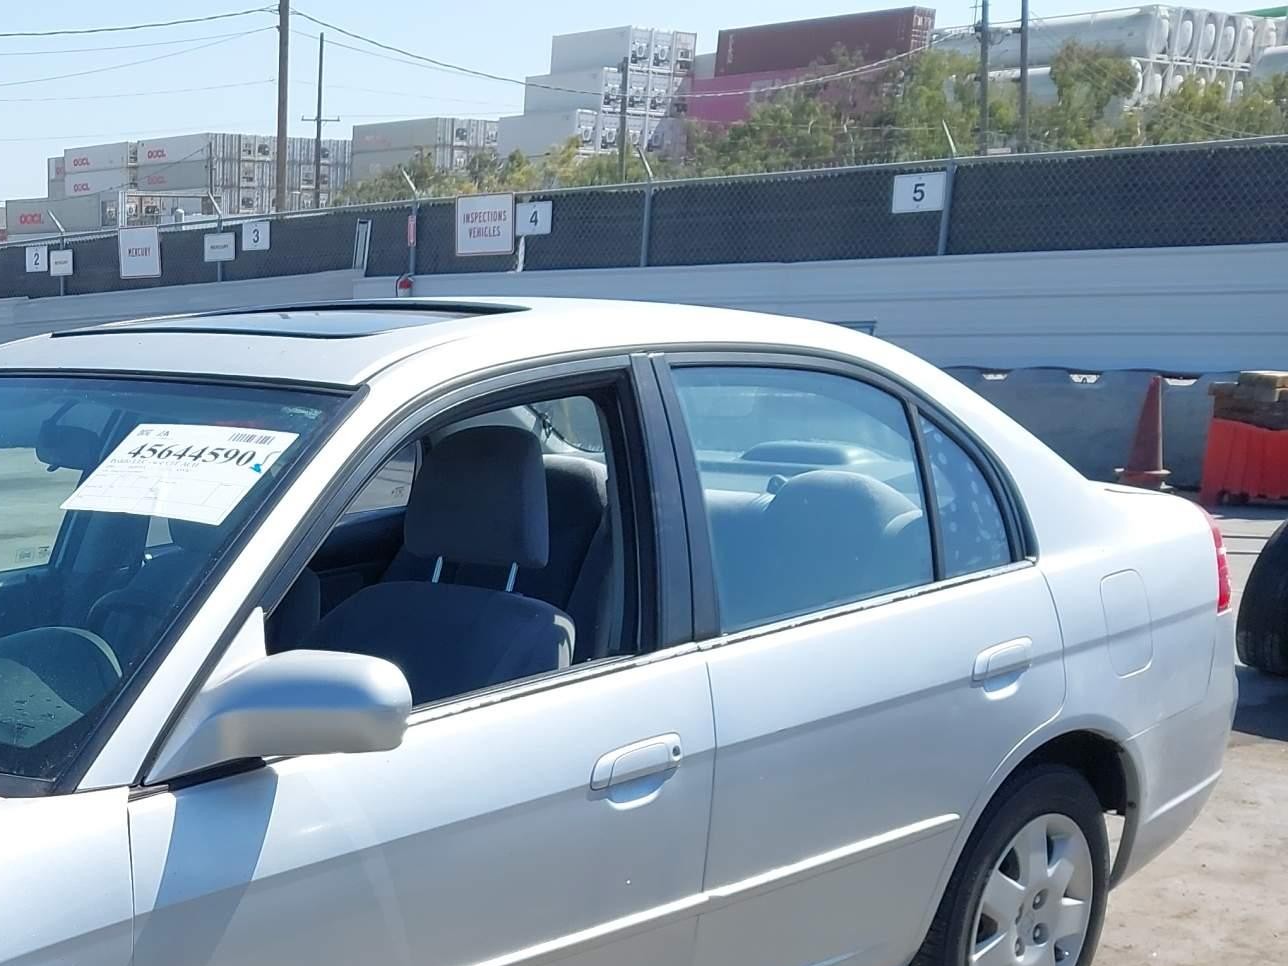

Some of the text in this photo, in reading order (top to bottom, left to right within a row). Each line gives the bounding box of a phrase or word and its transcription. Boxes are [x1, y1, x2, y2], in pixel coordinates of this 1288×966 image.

[913, 183, 925, 202] 5
[463, 210, 507, 225] INSPECTIONS
[529, 210, 539, 226] 4
[252, 228, 260, 243] 3
[468, 226, 501, 239] VEHICLES
[33, 253, 40, 266] 2
[128, 247, 152, 257] MERCURY
[127, 442, 257, 467] 45644590
